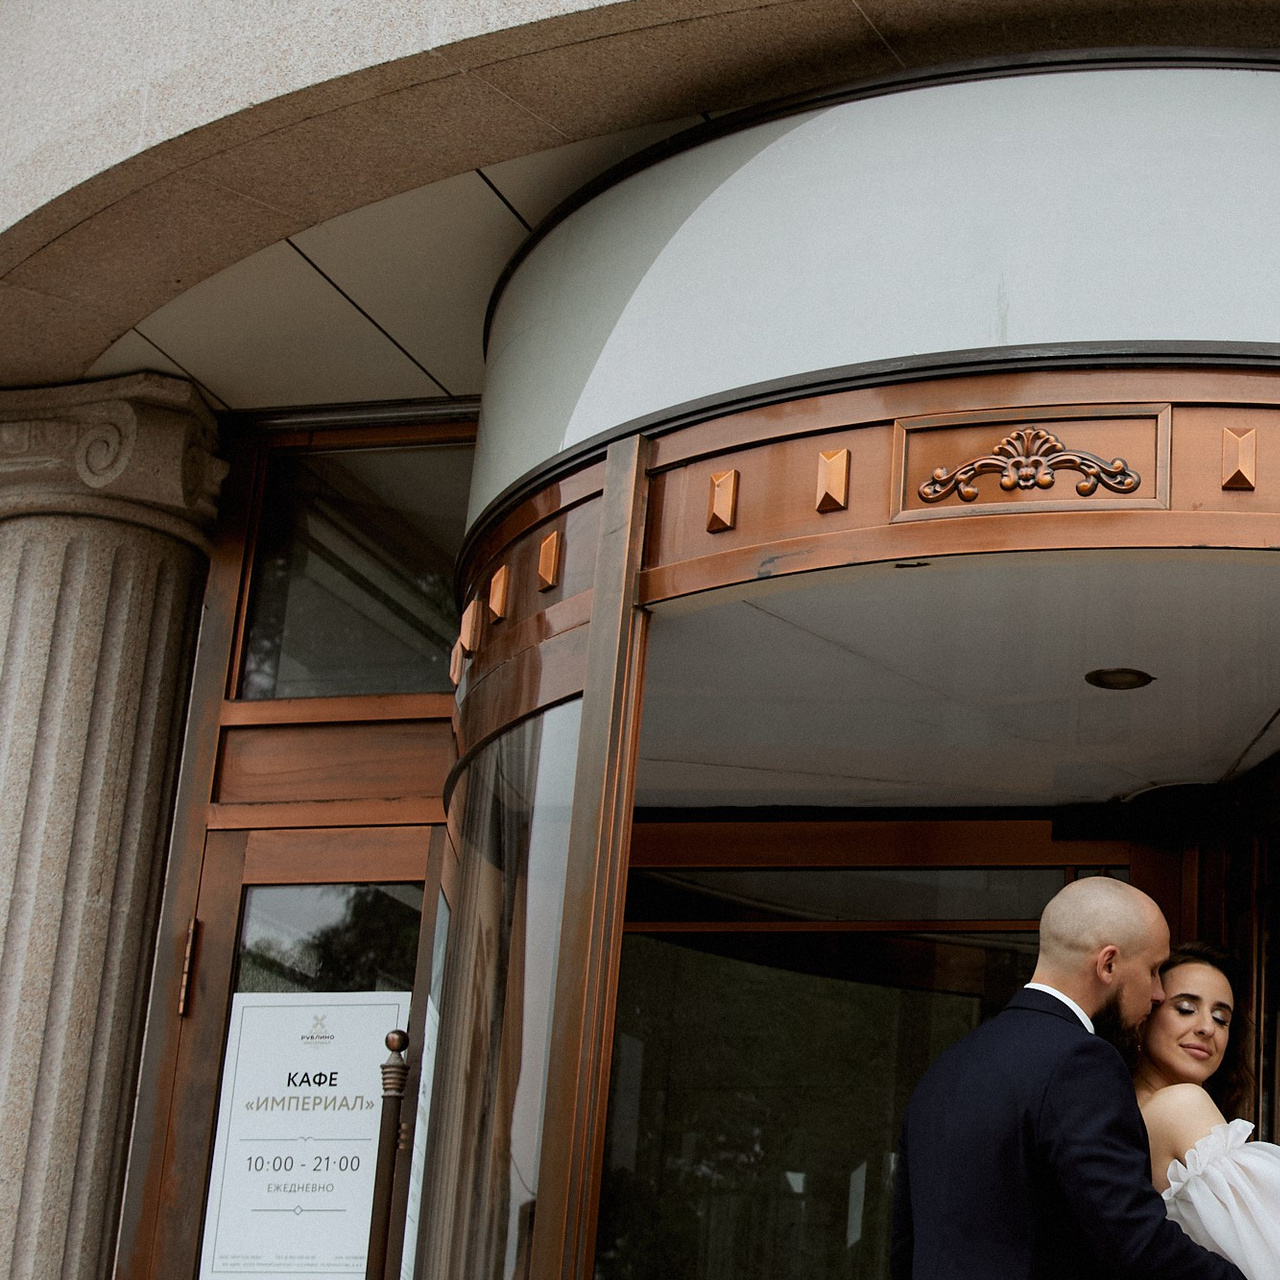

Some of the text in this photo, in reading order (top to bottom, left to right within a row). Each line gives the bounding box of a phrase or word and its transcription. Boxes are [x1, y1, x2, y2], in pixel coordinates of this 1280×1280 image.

[286, 1071, 339, 1088] КАФЕ
[245, 1095, 375, 1112] «ИМПЕРИАЛ»
[247, 1155, 295, 1173] 10:00
[266, 1183, 335, 1194] ЕЖЕДНЕВНО
